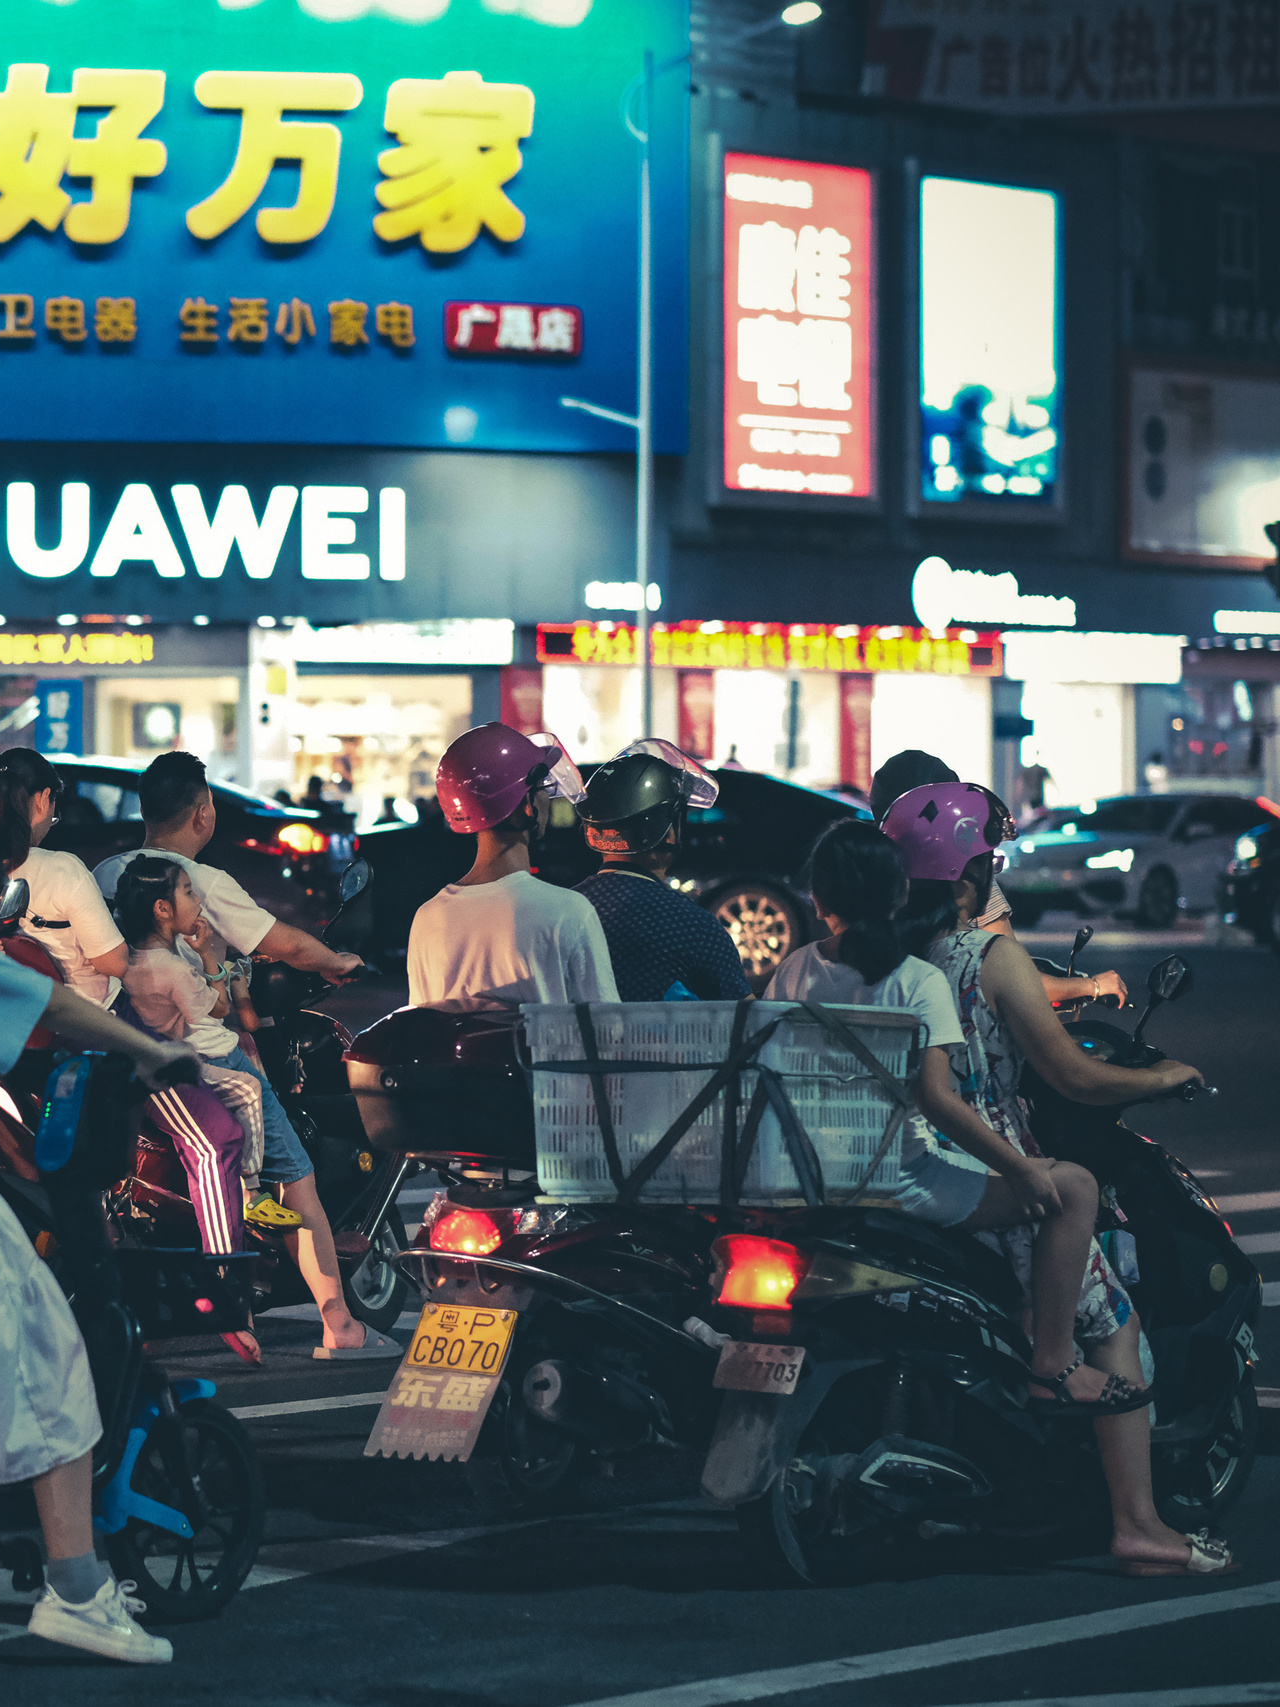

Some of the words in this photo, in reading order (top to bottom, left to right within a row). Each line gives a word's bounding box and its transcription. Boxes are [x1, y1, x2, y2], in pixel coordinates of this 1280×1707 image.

[178, 296, 416, 348] 生活小家电
[412, 1335, 500, 1370] CB070
[391, 1371, 491, 1412] 东盛
